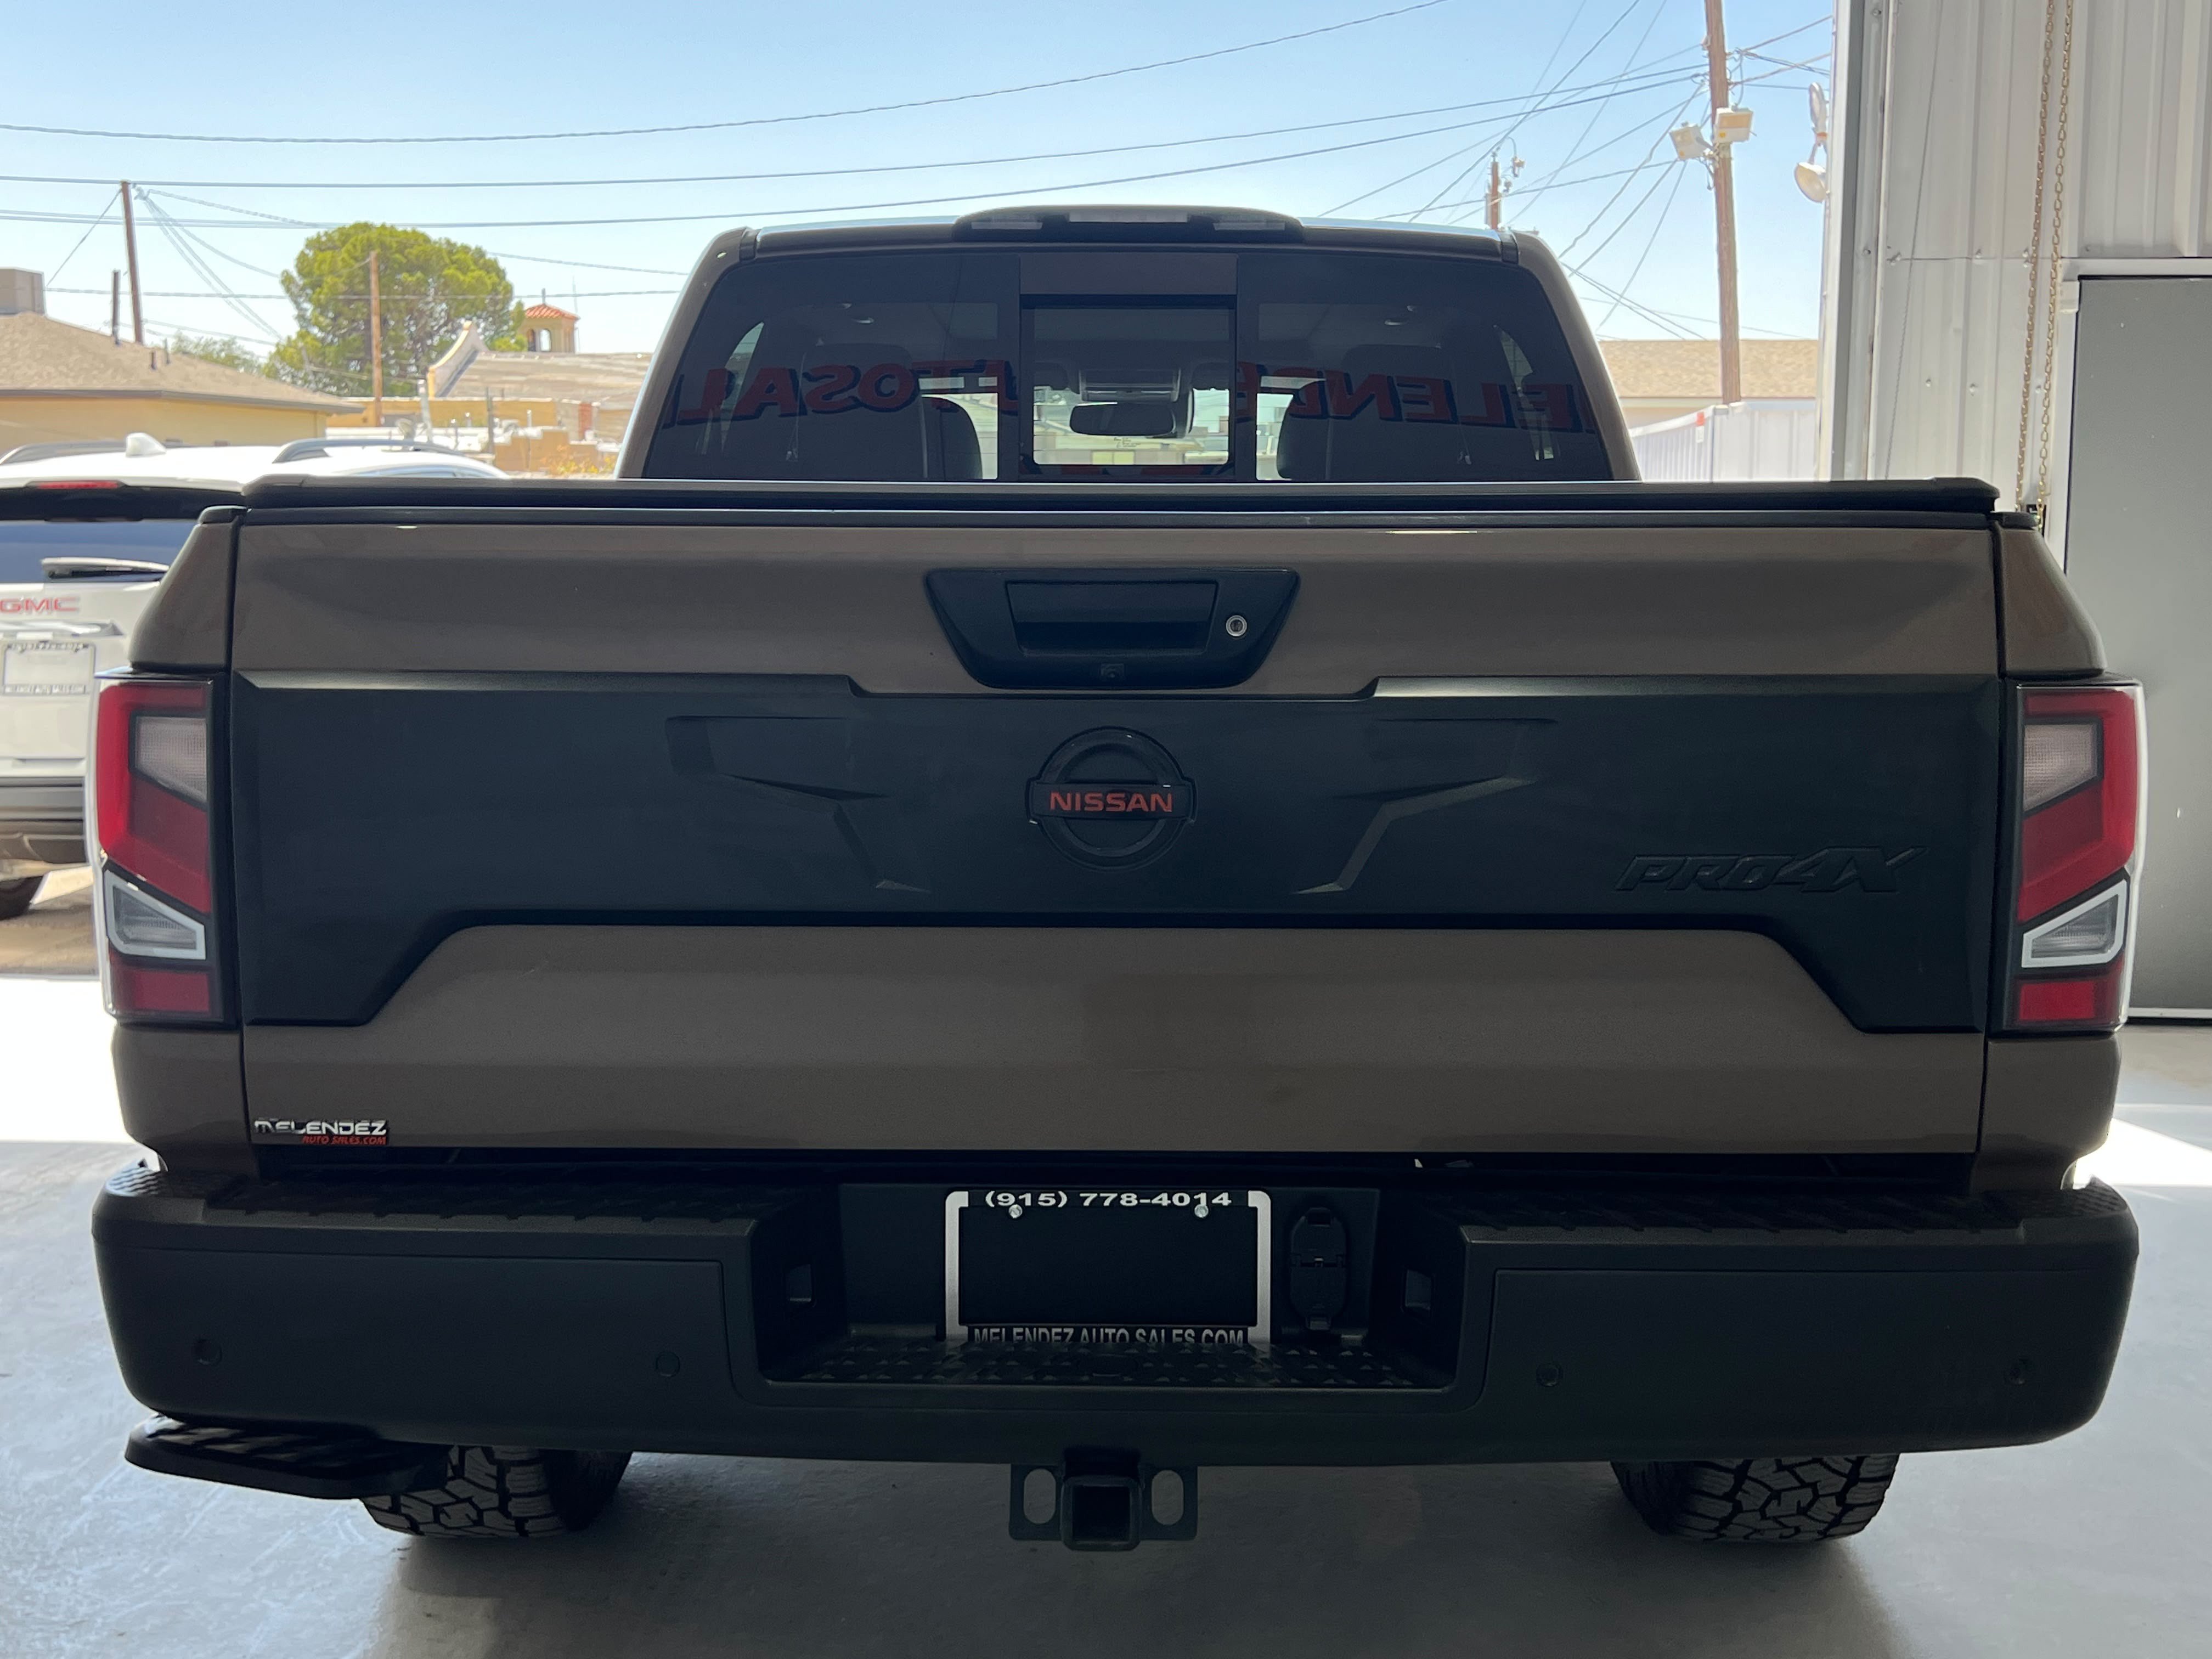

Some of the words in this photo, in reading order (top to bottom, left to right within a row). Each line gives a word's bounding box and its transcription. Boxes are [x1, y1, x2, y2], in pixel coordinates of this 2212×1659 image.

[0, 597, 79, 612] GMC
[1050, 791, 1173, 812] NISSAN
[302, 1136, 329, 1144] AUTO
[986, 1190, 1067, 1207] (915)
[1079, 1192, 1232, 1207] 778-4014
[1080, 1328, 1130, 1344] AUTO
